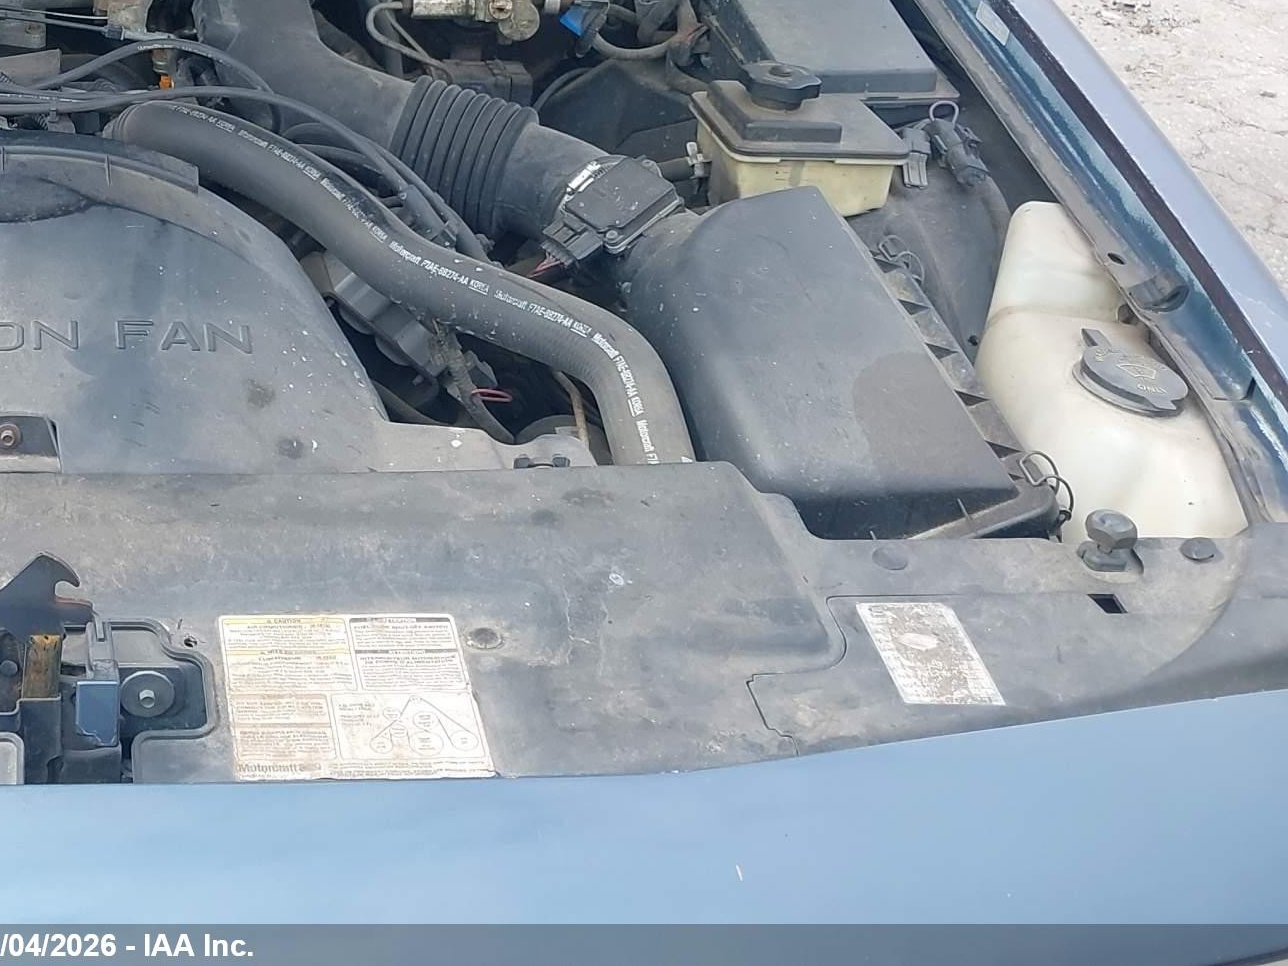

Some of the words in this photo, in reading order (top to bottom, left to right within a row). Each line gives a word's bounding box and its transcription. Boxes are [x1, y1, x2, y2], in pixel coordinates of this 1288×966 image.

[389, 241, 422, 265] Motorcraft
[468, 278, 490, 296] KOREA
[494, 289, 529, 311] Motorcraft
[116, 320, 253, 355] FAN
[591, 332, 620, 359] Motorcraft
[636, 419, 655, 452] Motorcraft
